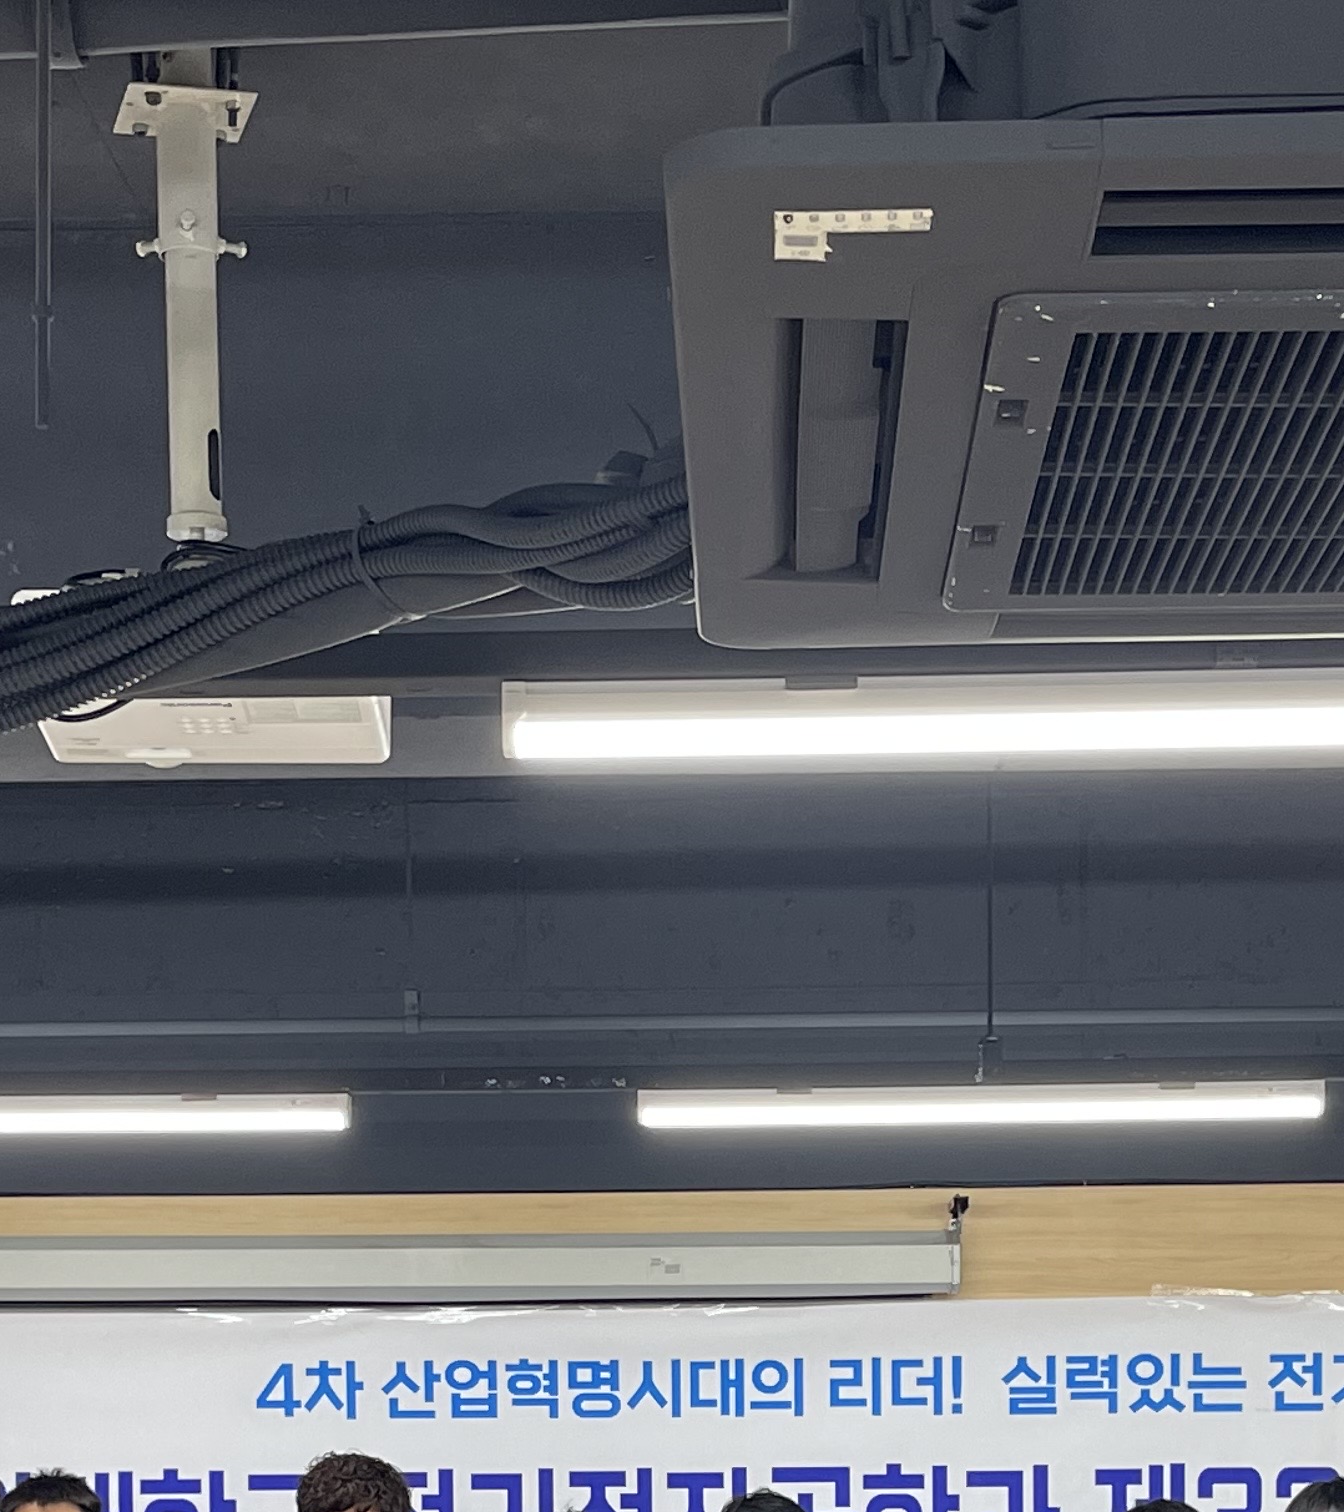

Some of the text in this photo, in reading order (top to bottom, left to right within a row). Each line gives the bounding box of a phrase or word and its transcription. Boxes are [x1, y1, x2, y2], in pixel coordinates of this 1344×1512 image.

[257, 1360, 364, 1420] 4차
[382, 1357, 805, 1420] 산업혁명시대의
[830, 1355, 964, 1415] 리더!
[1002, 1352, 1247, 1415] 실력있는
